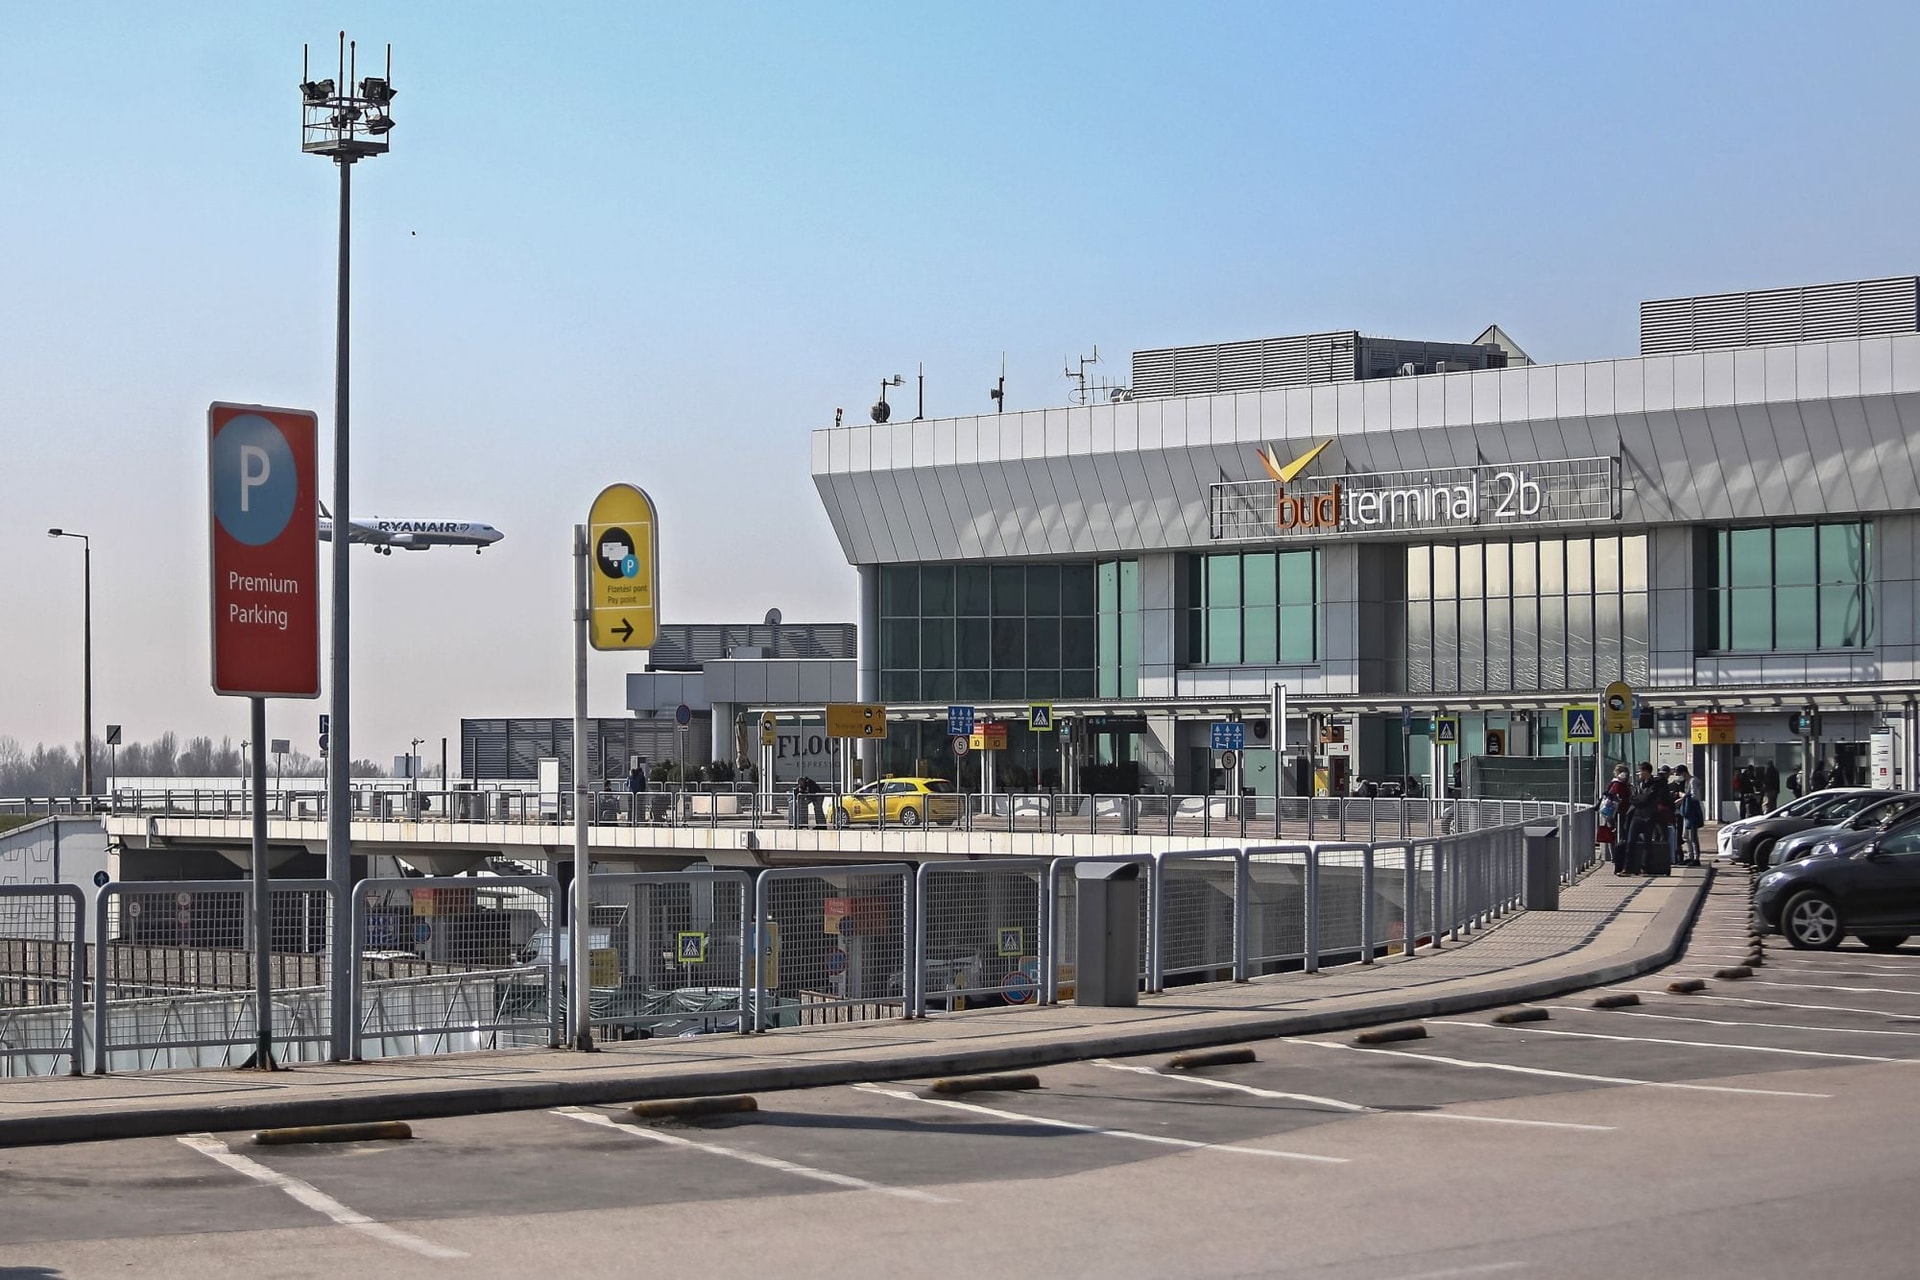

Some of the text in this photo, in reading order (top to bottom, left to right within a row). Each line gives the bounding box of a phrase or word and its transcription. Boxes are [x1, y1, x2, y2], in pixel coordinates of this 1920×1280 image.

[240, 445, 271, 512] P
[1494, 471, 1541, 517] 2b
[378, 521, 458, 533] RYANAIR
[627, 559, 635, 573] P
[229, 571, 298, 594] Premium
[607, 595, 637, 605] Pay point
[230, 603, 288, 630] Parking
[958, 742, 964, 750] 5
